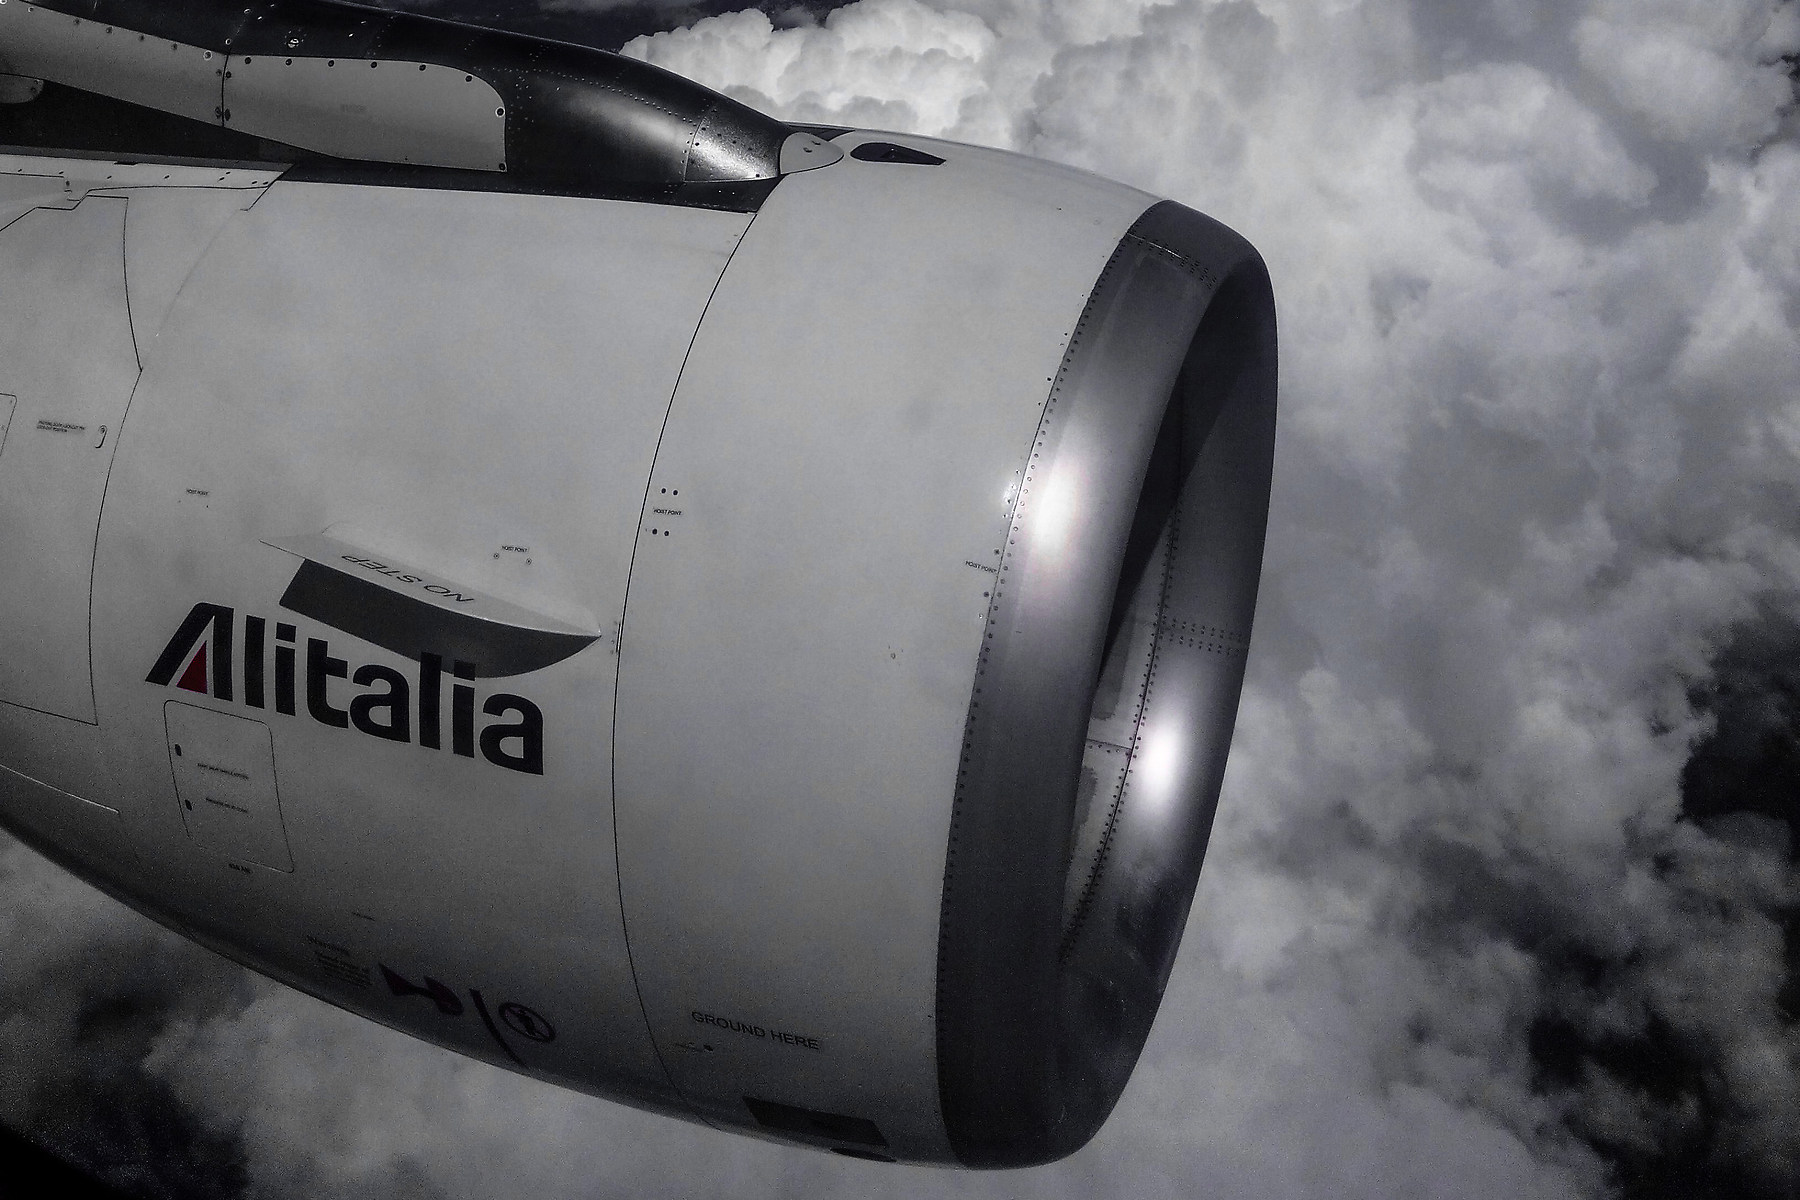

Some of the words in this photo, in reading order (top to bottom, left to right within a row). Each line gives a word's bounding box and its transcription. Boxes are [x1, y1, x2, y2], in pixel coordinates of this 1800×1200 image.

[341, 555, 423, 583] STEP
[423, 585, 475, 602] NO
[145, 602, 543, 775] Alitalia
[691, 1011, 766, 1038] GROUND
[770, 1029, 820, 1051] HERE
